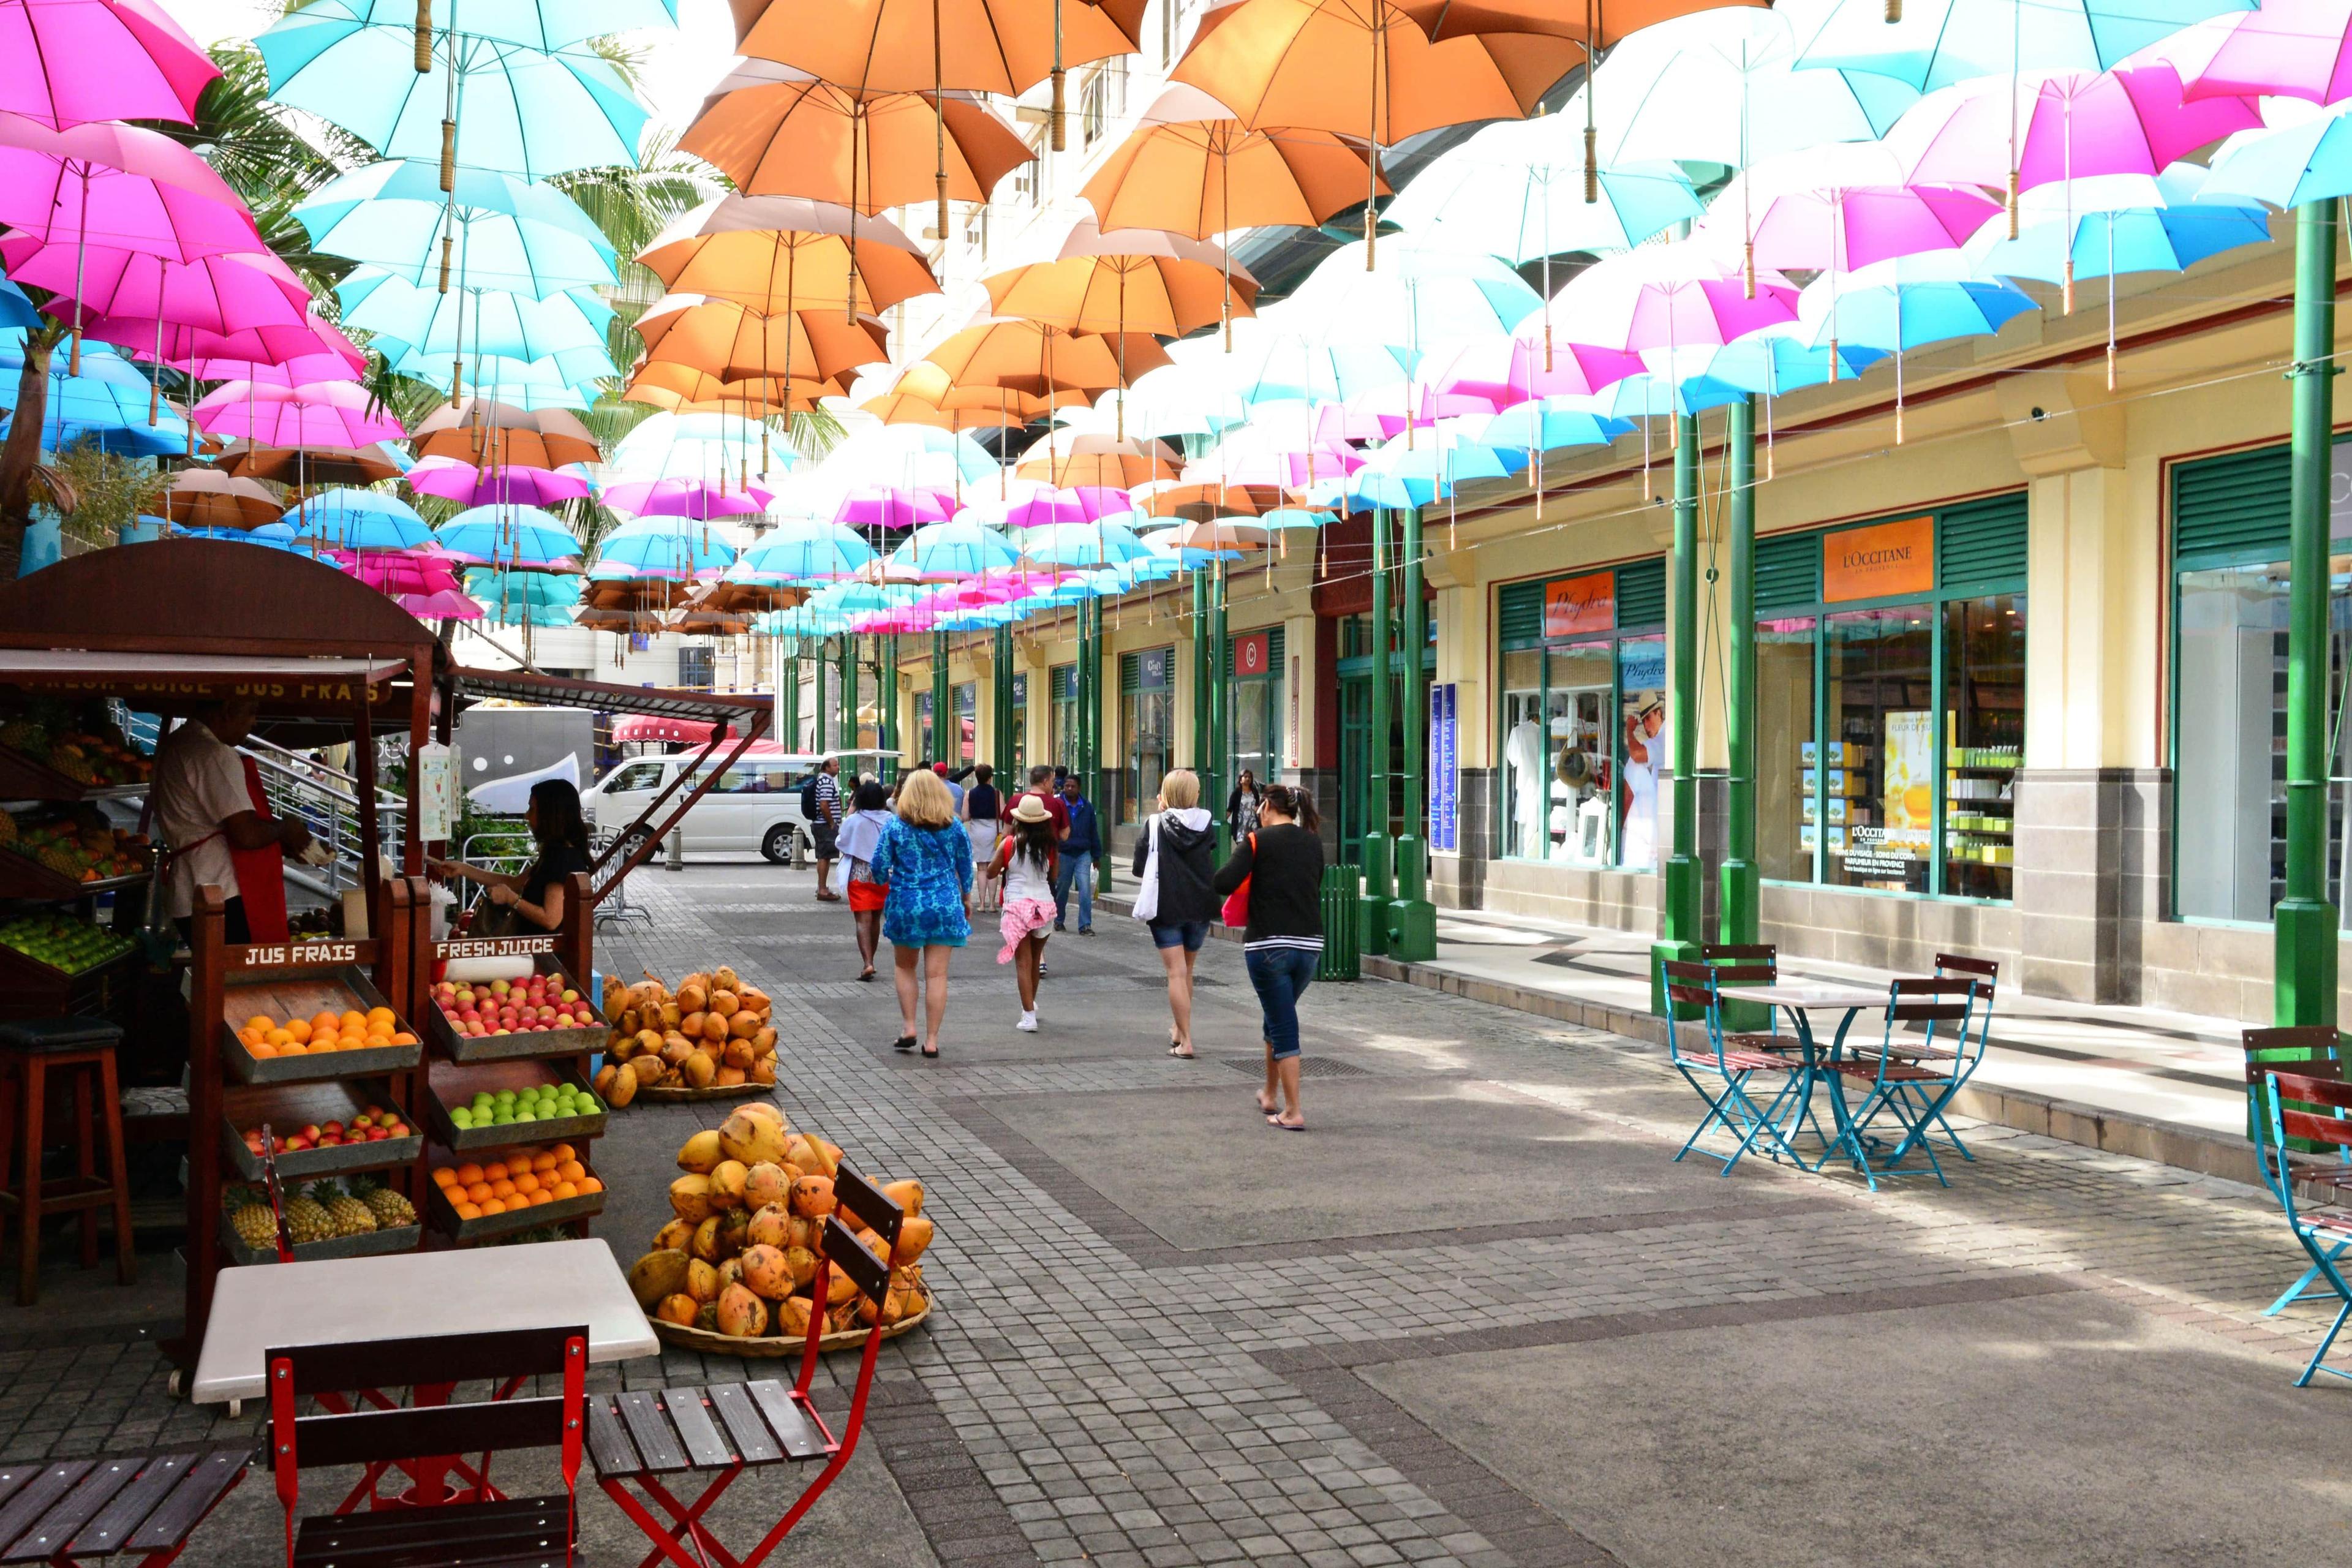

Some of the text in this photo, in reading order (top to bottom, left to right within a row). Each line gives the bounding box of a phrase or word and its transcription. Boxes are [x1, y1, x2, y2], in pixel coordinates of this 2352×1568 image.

[1844, 546, 1912, 568] L'OCCITANE
[301, 682, 379, 702] FRAS
[1852, 825, 1895, 837] L'OCCITA
[246, 944, 356, 965] JUS FRAIS
[437, 938, 554, 959] FRESH JUICE
